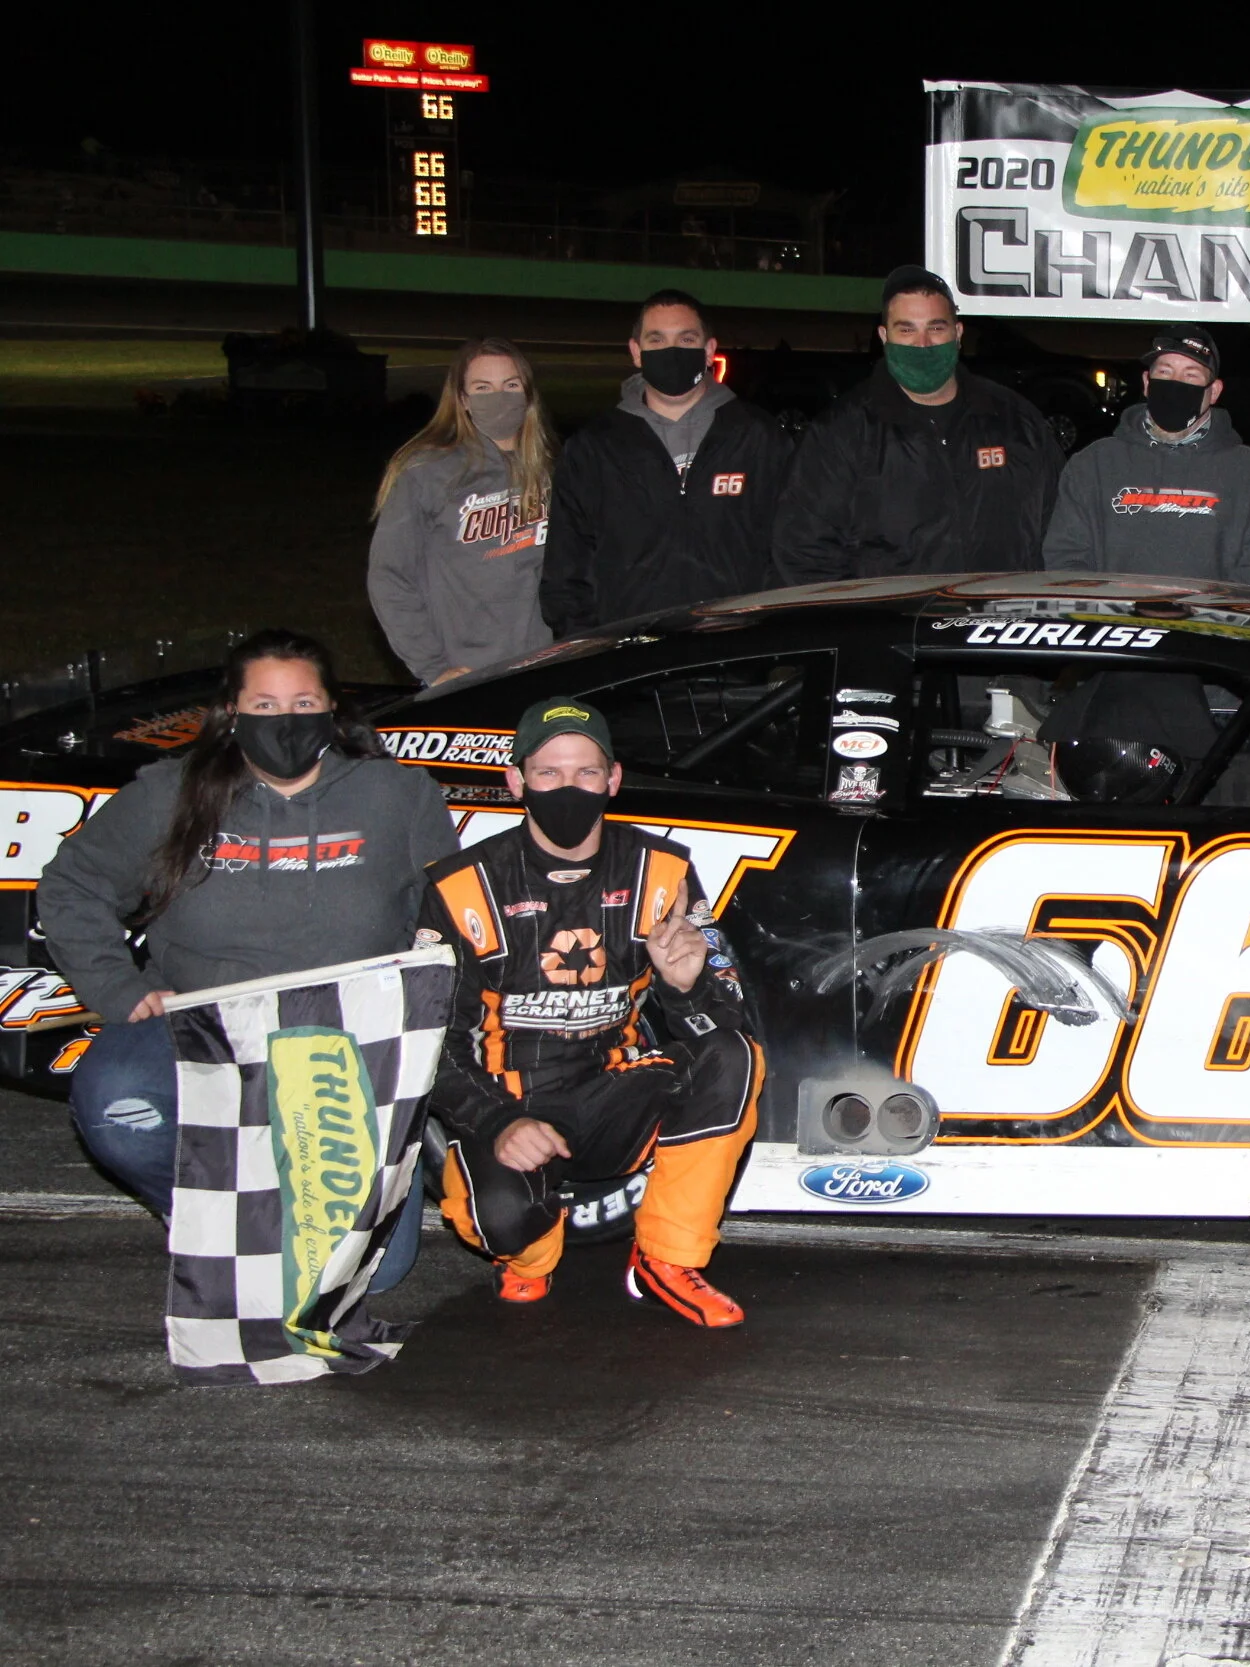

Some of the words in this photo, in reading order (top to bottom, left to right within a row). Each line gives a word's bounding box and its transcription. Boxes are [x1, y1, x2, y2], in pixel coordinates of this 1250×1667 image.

[422, 95, 454, 120] 66
[414, 151, 446, 178] 66
[956, 157, 1055, 190] 2020
[414, 180, 447, 207] 66
[415, 209, 448, 236] 66
[977, 447, 1006, 468] 66
[712, 474, 745, 495] 66
[966, 622, 1171, 648] CORLISS
[380, 732, 448, 760] ARD
[450, 733, 514, 749] BROTHE
[503, 985, 630, 1008] BURNET
[504, 1006, 568, 1016] SCRAP
[824, 1162, 904, 1199] Ford
[301, 1179, 319, 1209] site
[300, 1213, 327, 1235] of
